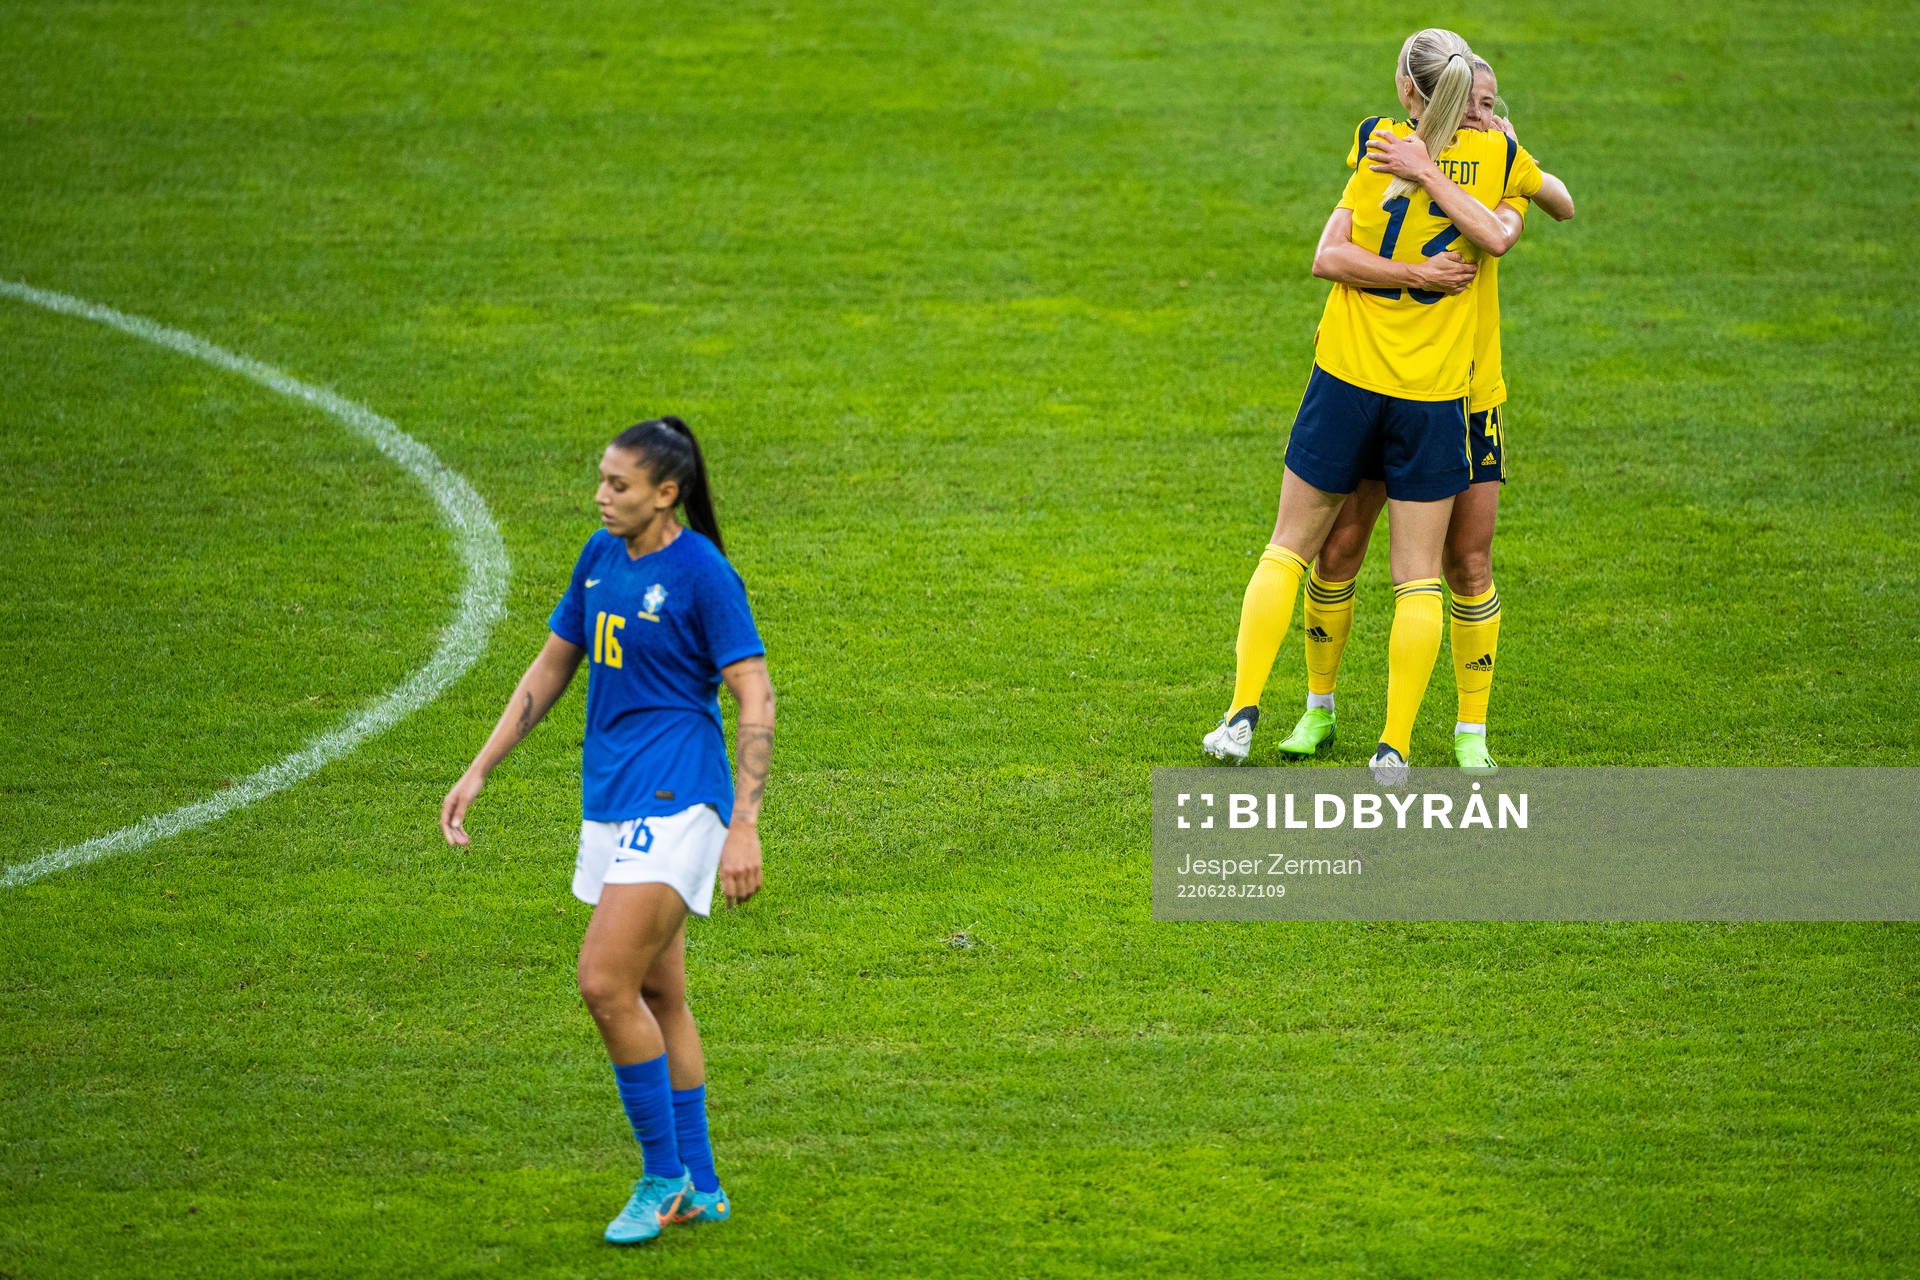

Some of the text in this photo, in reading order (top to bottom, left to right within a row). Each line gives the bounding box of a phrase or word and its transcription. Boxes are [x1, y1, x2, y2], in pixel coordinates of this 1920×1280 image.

[1434, 160, 1479, 186] TEDT
[1485, 408, 1498, 446] 4
[594, 611, 626, 669] 16
